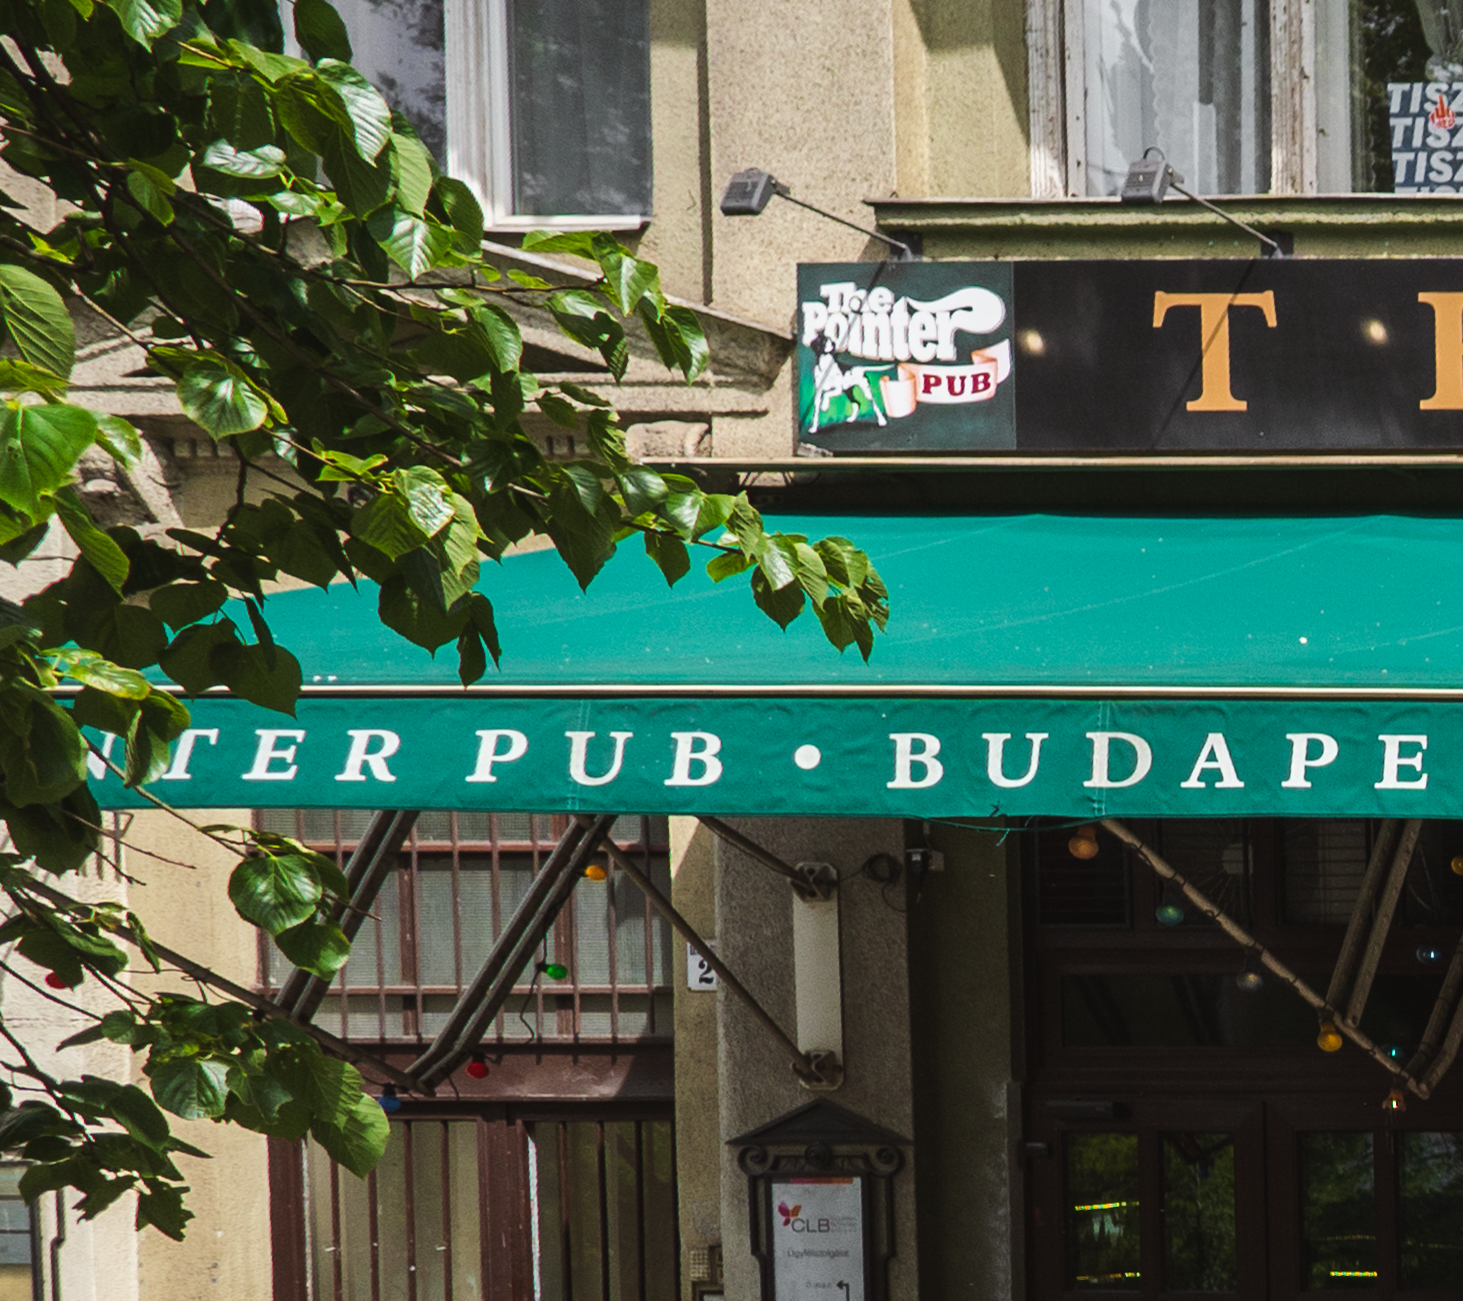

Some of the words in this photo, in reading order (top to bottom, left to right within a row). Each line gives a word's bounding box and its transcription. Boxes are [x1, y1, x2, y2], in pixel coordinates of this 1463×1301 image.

[821, 282, 894, 313] The
[802, 288, 1004, 362] Pointer
[922, 373, 991, 396] PUB
[465, 729, 725, 786] PUB
[698, 959, 715, 985] 2
[791, 1218, 831, 1234] CLB
